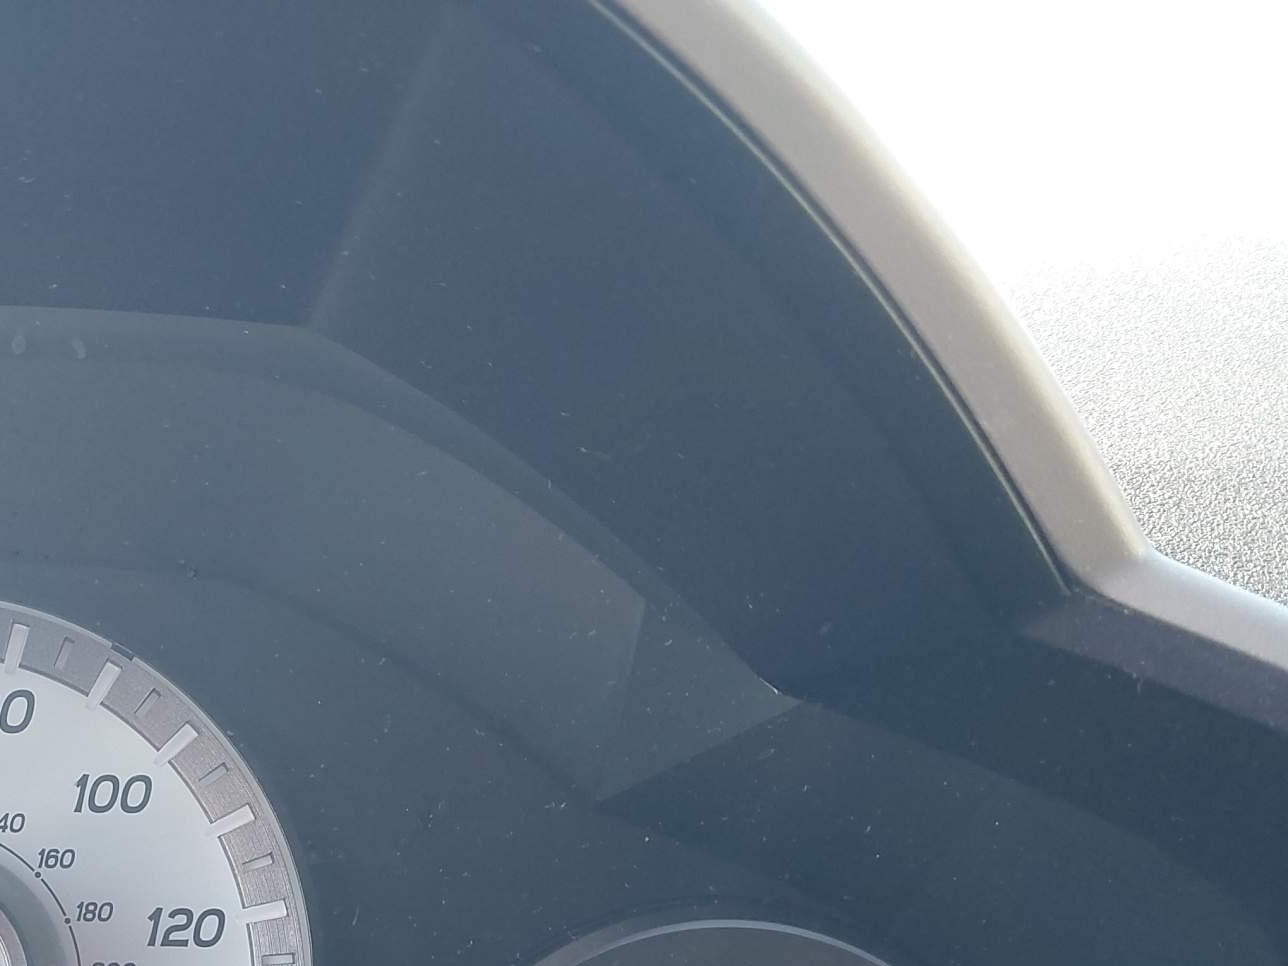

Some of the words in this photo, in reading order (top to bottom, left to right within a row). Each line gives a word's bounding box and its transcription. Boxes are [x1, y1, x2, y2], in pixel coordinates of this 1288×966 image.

[74, 774, 152, 813] 100
[38, 849, 75, 868] 160
[76, 902, 113, 922] 180
[147, 908, 225, 947] 120
